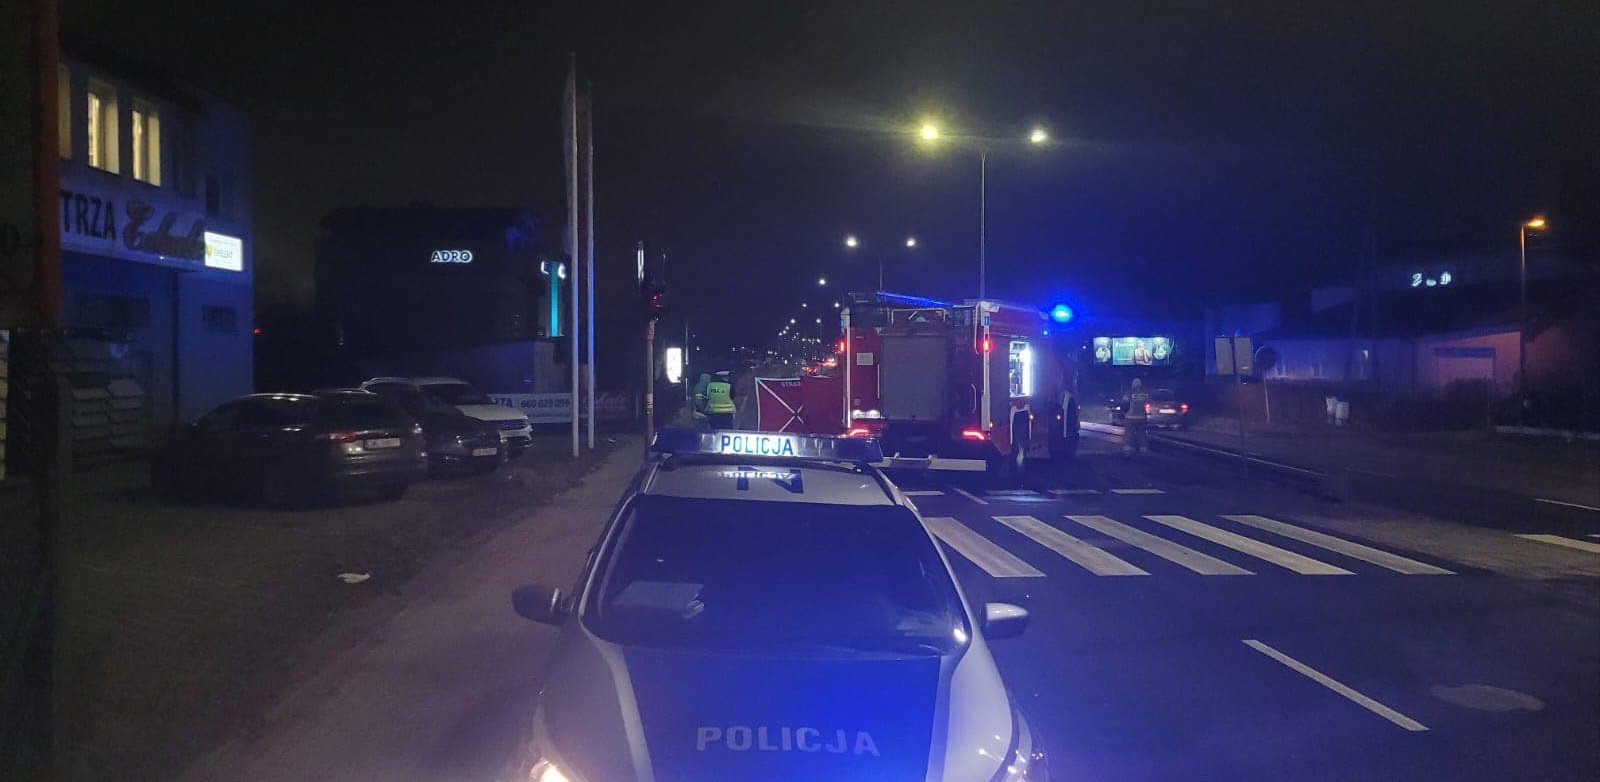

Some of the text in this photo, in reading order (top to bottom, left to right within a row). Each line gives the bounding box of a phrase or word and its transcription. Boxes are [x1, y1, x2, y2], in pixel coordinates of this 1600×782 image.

[431, 250, 473, 263] ADRO
[721, 435, 794, 456] POLICJA
[696, 725, 881, 757] POLICJA
